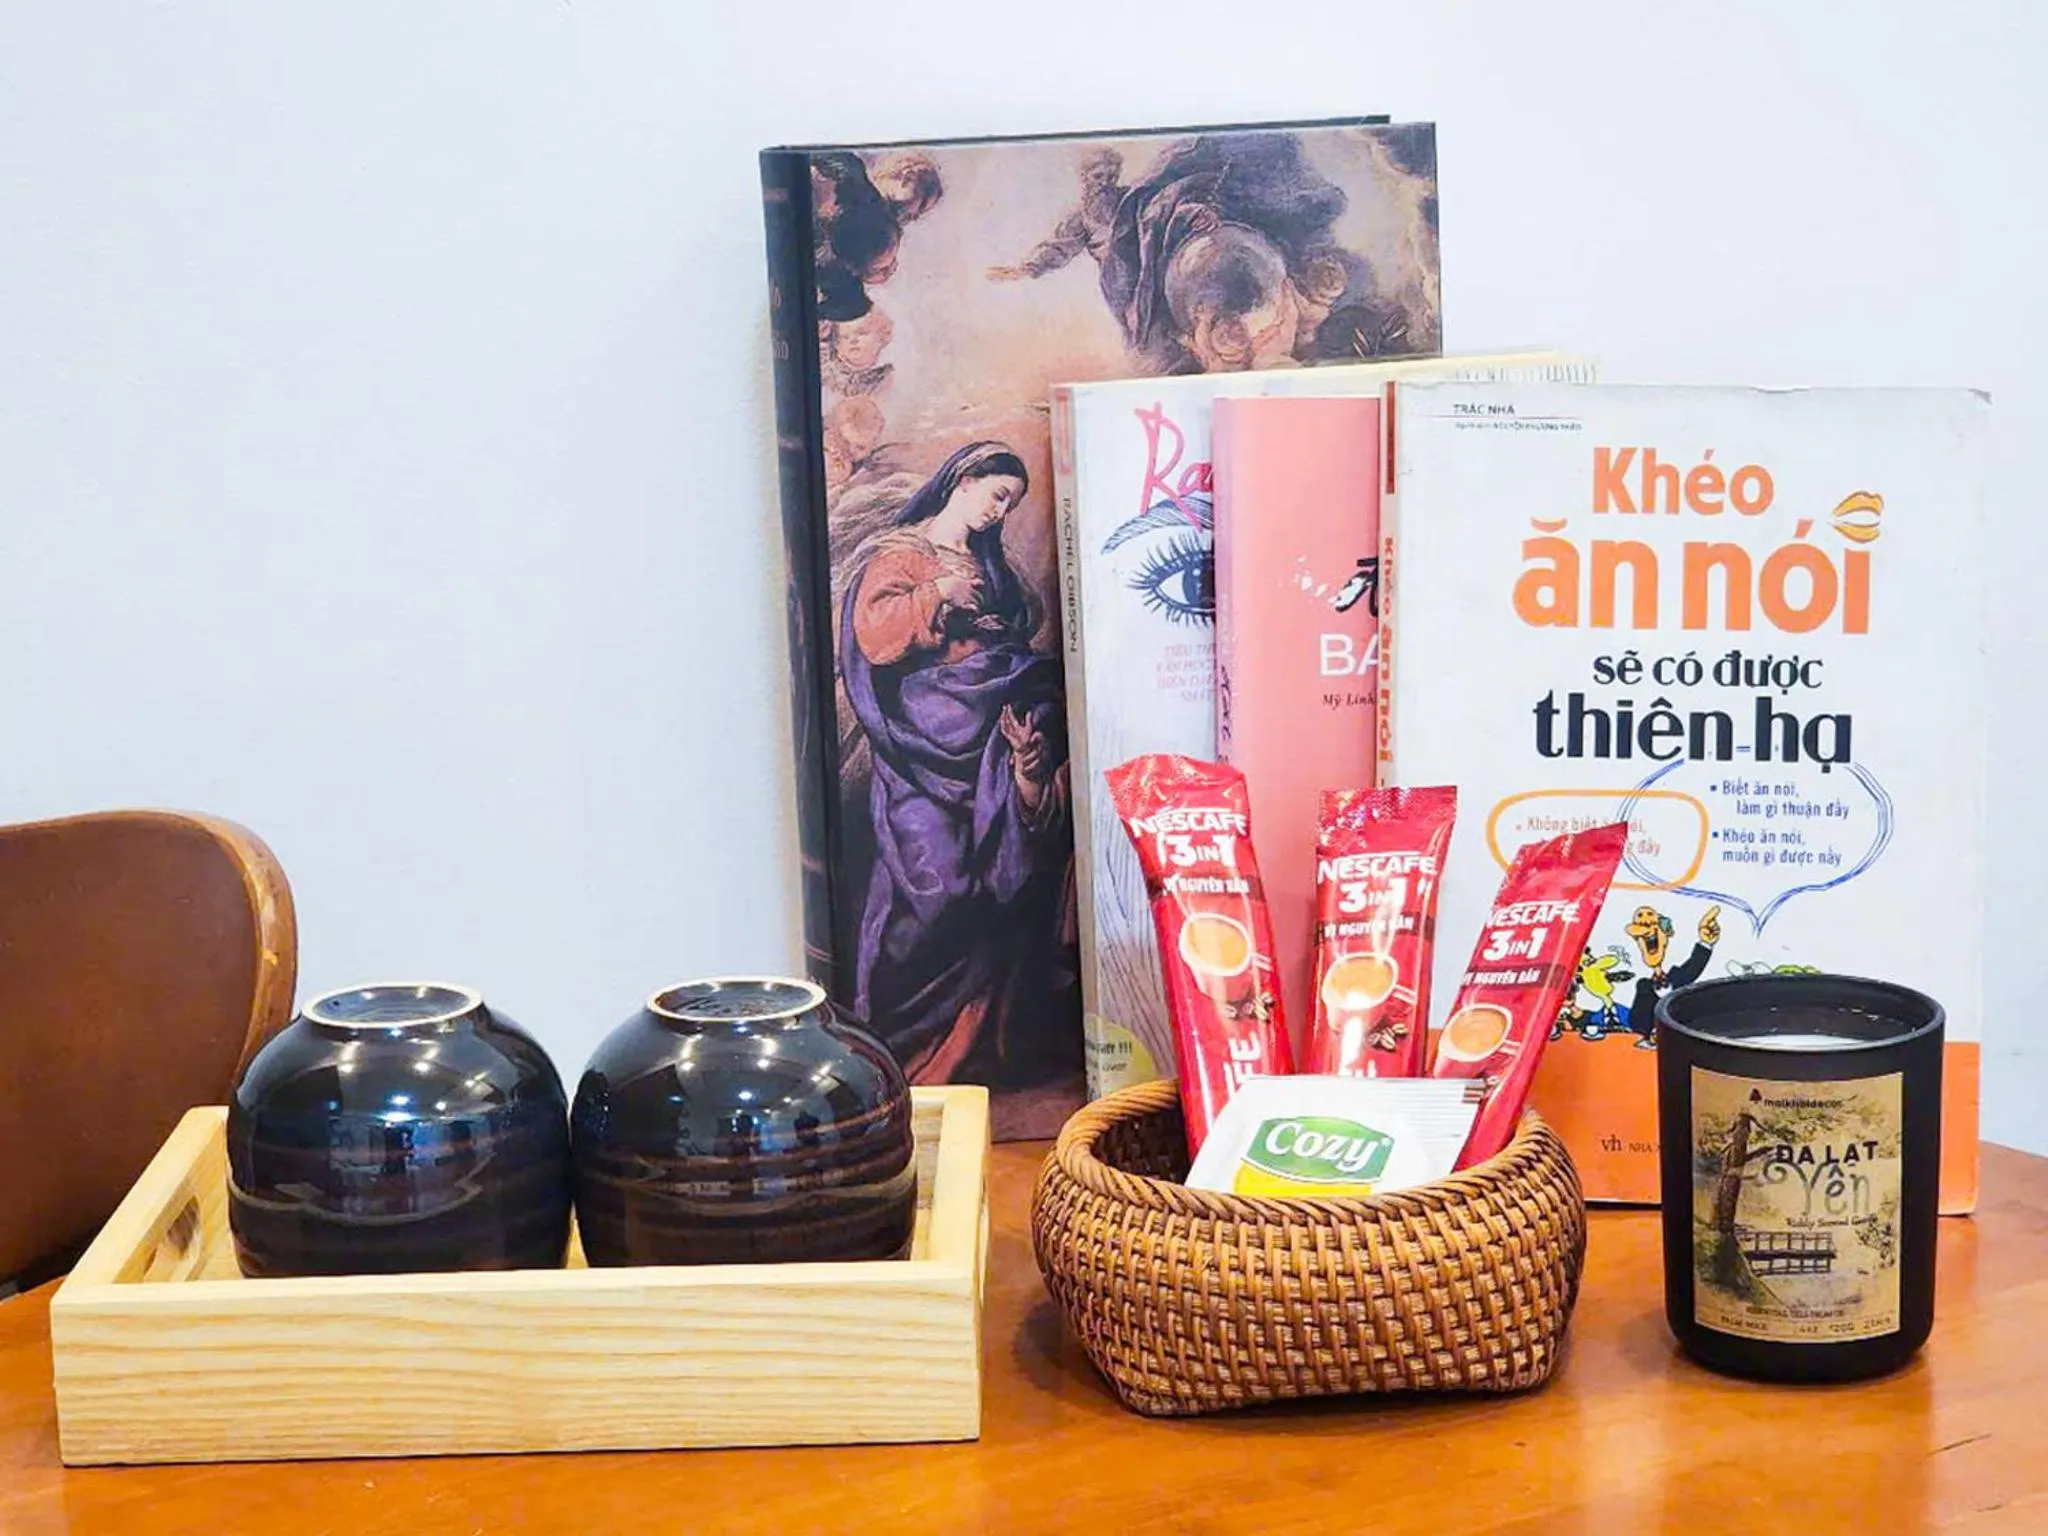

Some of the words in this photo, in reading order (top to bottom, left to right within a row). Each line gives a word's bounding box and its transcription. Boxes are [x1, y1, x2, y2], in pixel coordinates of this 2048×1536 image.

[1593, 446, 1774, 516] Khéo
[1063, 497, 1075, 571] RACHEL
[1512, 517, 1658, 630] ăn
[1682, 518, 1872, 635] nói
[1593, 650, 1643, 686] sẽ
[1652, 651, 1703, 687] có
[1712, 649, 1824, 694] được
[1532, 688, 1733, 761] thiên
[1754, 696, 1852, 773] hạ
[1722, 777, 1749, 796] Biết
[1753, 781, 1769, 796] ăn
[1527, 815, 1569, 834] Không
[1736, 800, 1761, 815] làm
[1782, 801, 1821, 819] thuận
[1722, 828, 1755, 844] Khéo
[1760, 828, 1776, 844] ăn
[1780, 849, 1814, 867] được
[1265, 1122, 1379, 1173] Cozy
